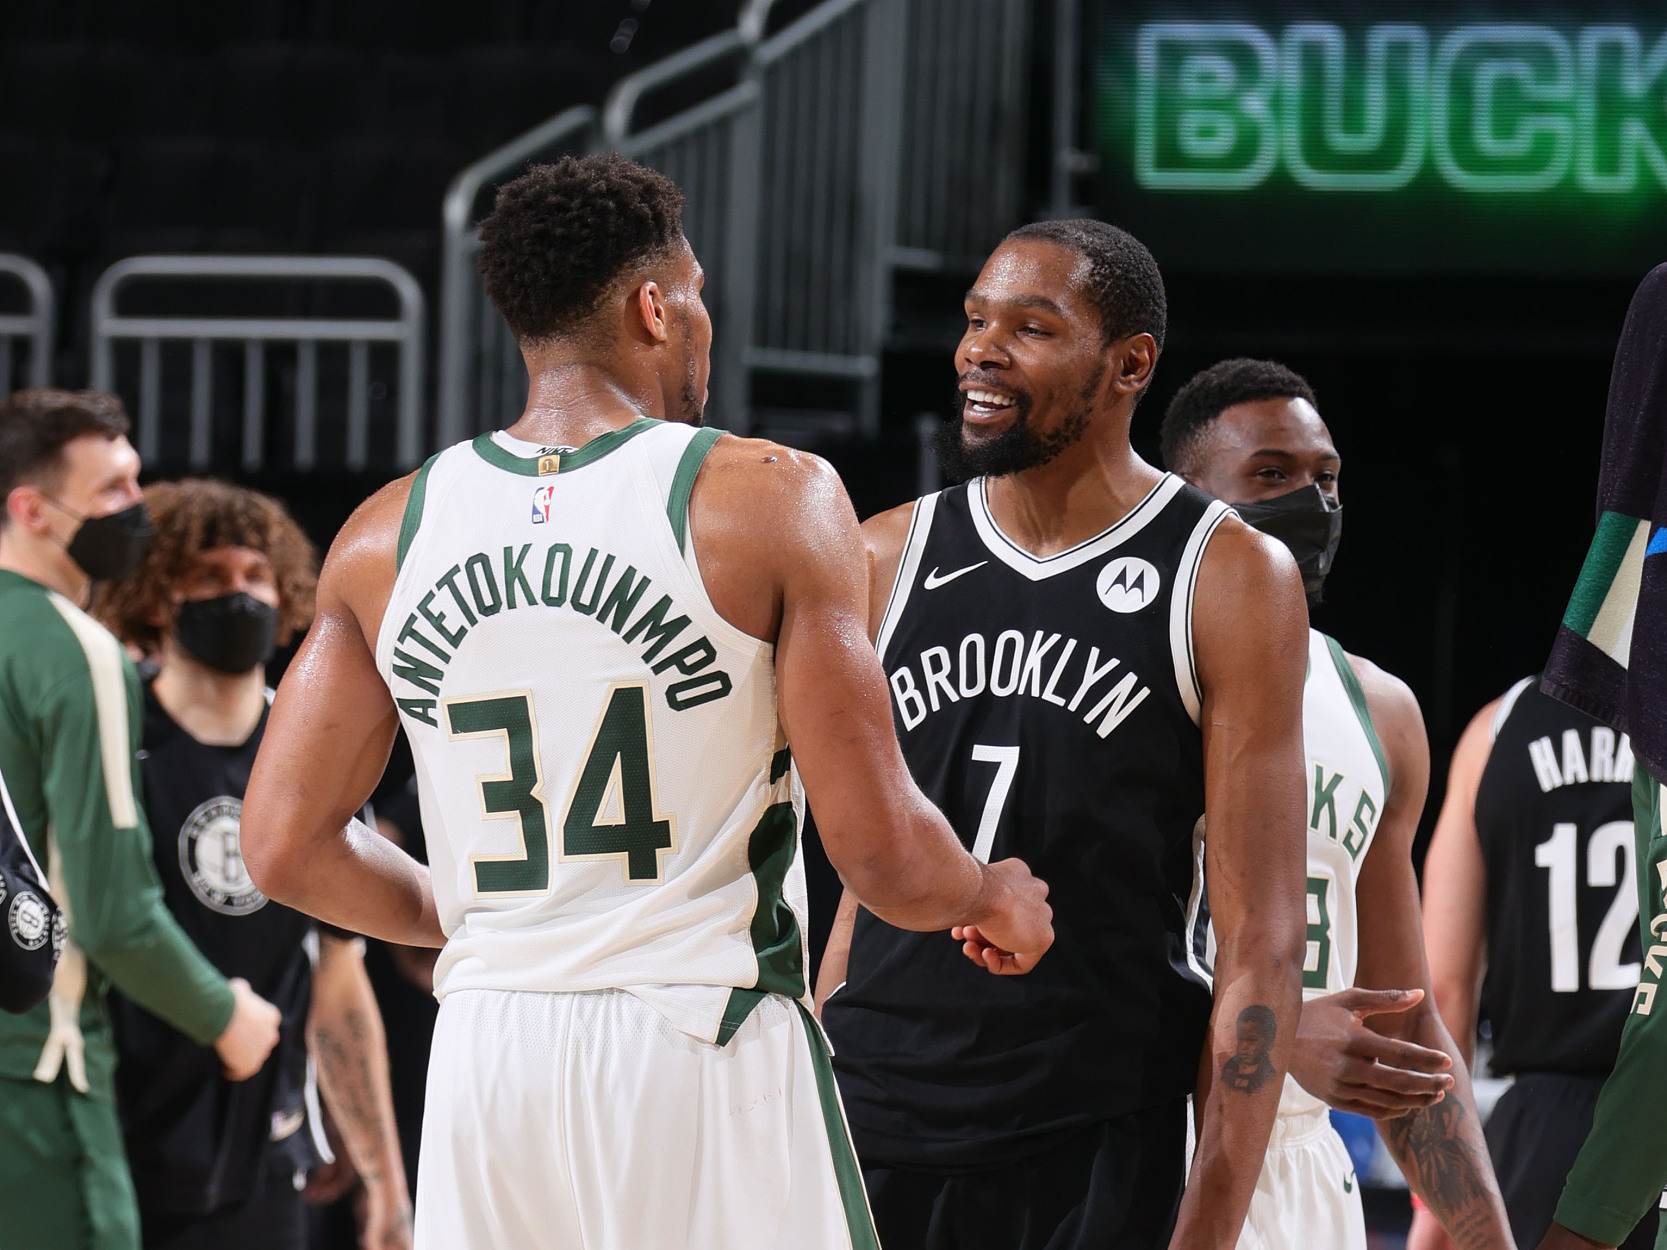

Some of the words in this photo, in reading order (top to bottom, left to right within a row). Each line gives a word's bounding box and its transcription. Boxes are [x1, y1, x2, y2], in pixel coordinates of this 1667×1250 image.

[391, 543, 732, 728] ANTETOKOUNMPO
[890, 629, 1151, 739] BROOKLYN
[442, 680, 677, 899] 34
[971, 744, 1020, 865] 7
[1535, 820, 1642, 993] 12
